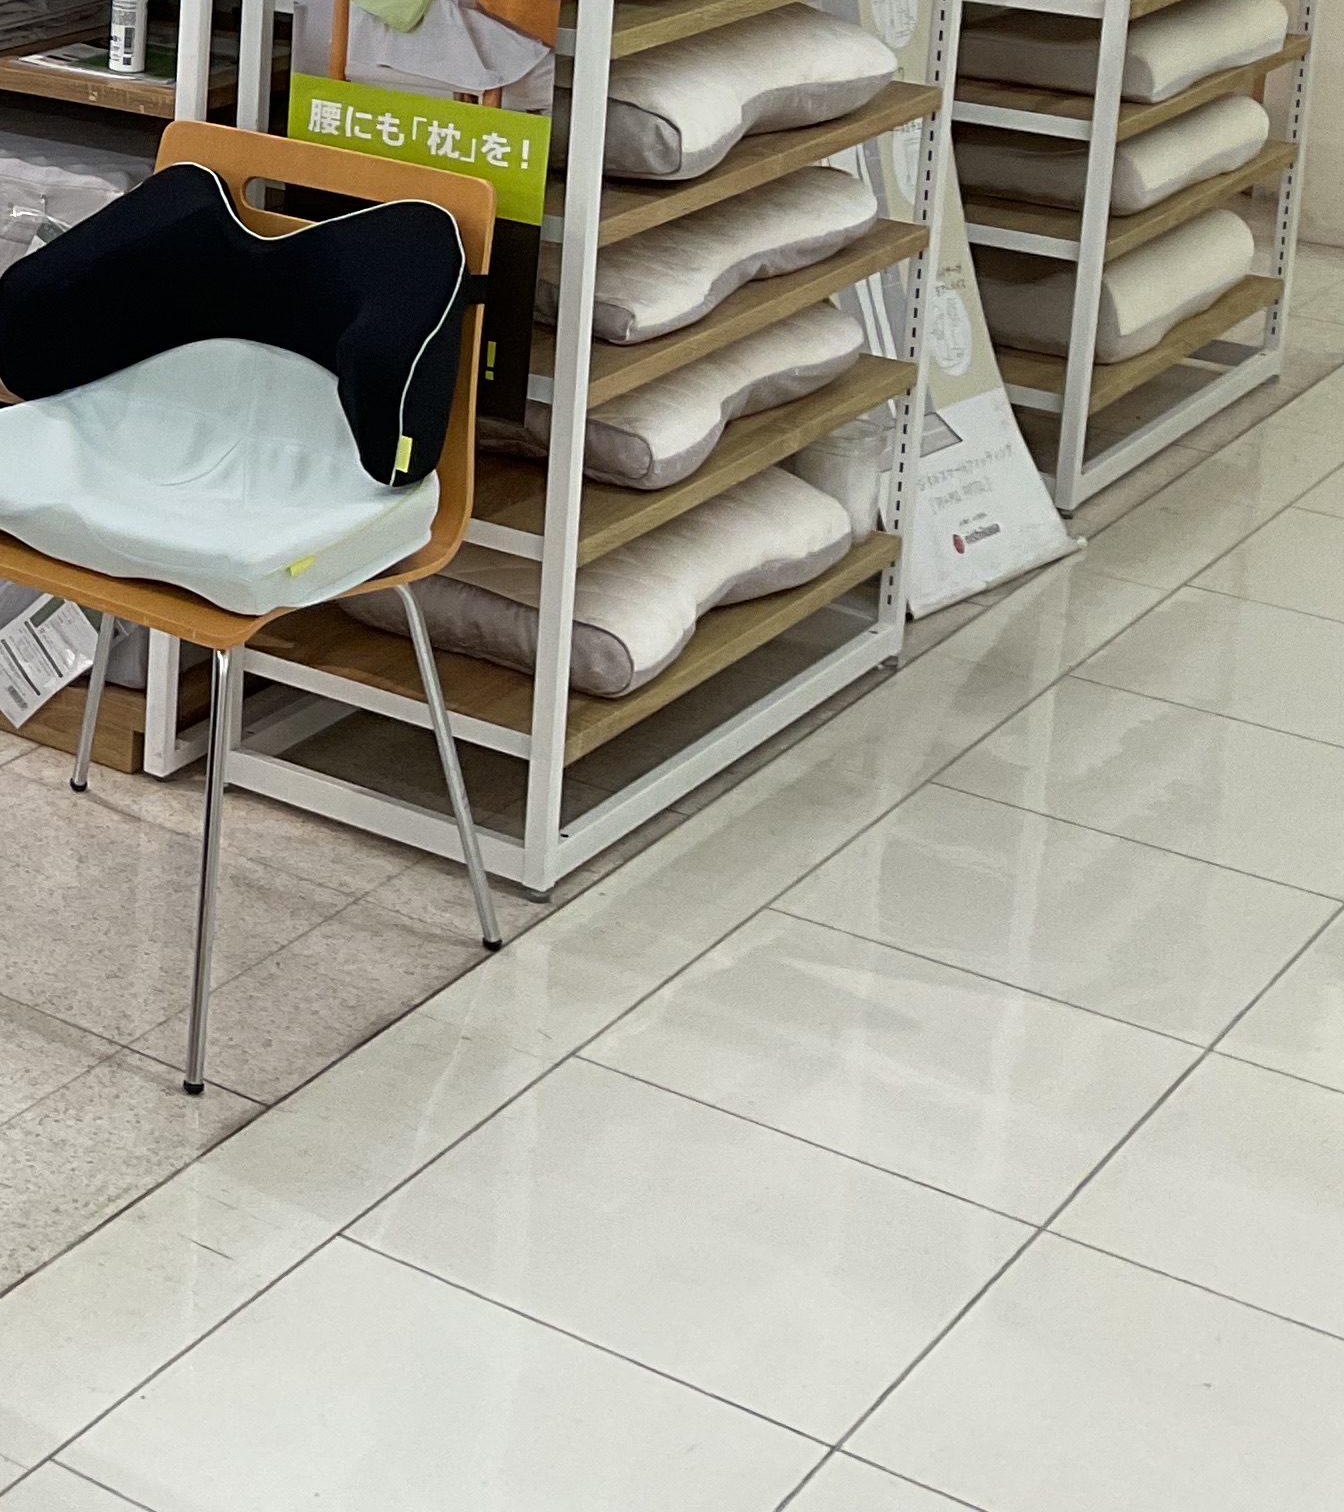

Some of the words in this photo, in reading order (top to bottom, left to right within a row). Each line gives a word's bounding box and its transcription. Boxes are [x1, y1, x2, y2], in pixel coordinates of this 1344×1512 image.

[308, 98, 531, 170] 腰にも「枕」を!
